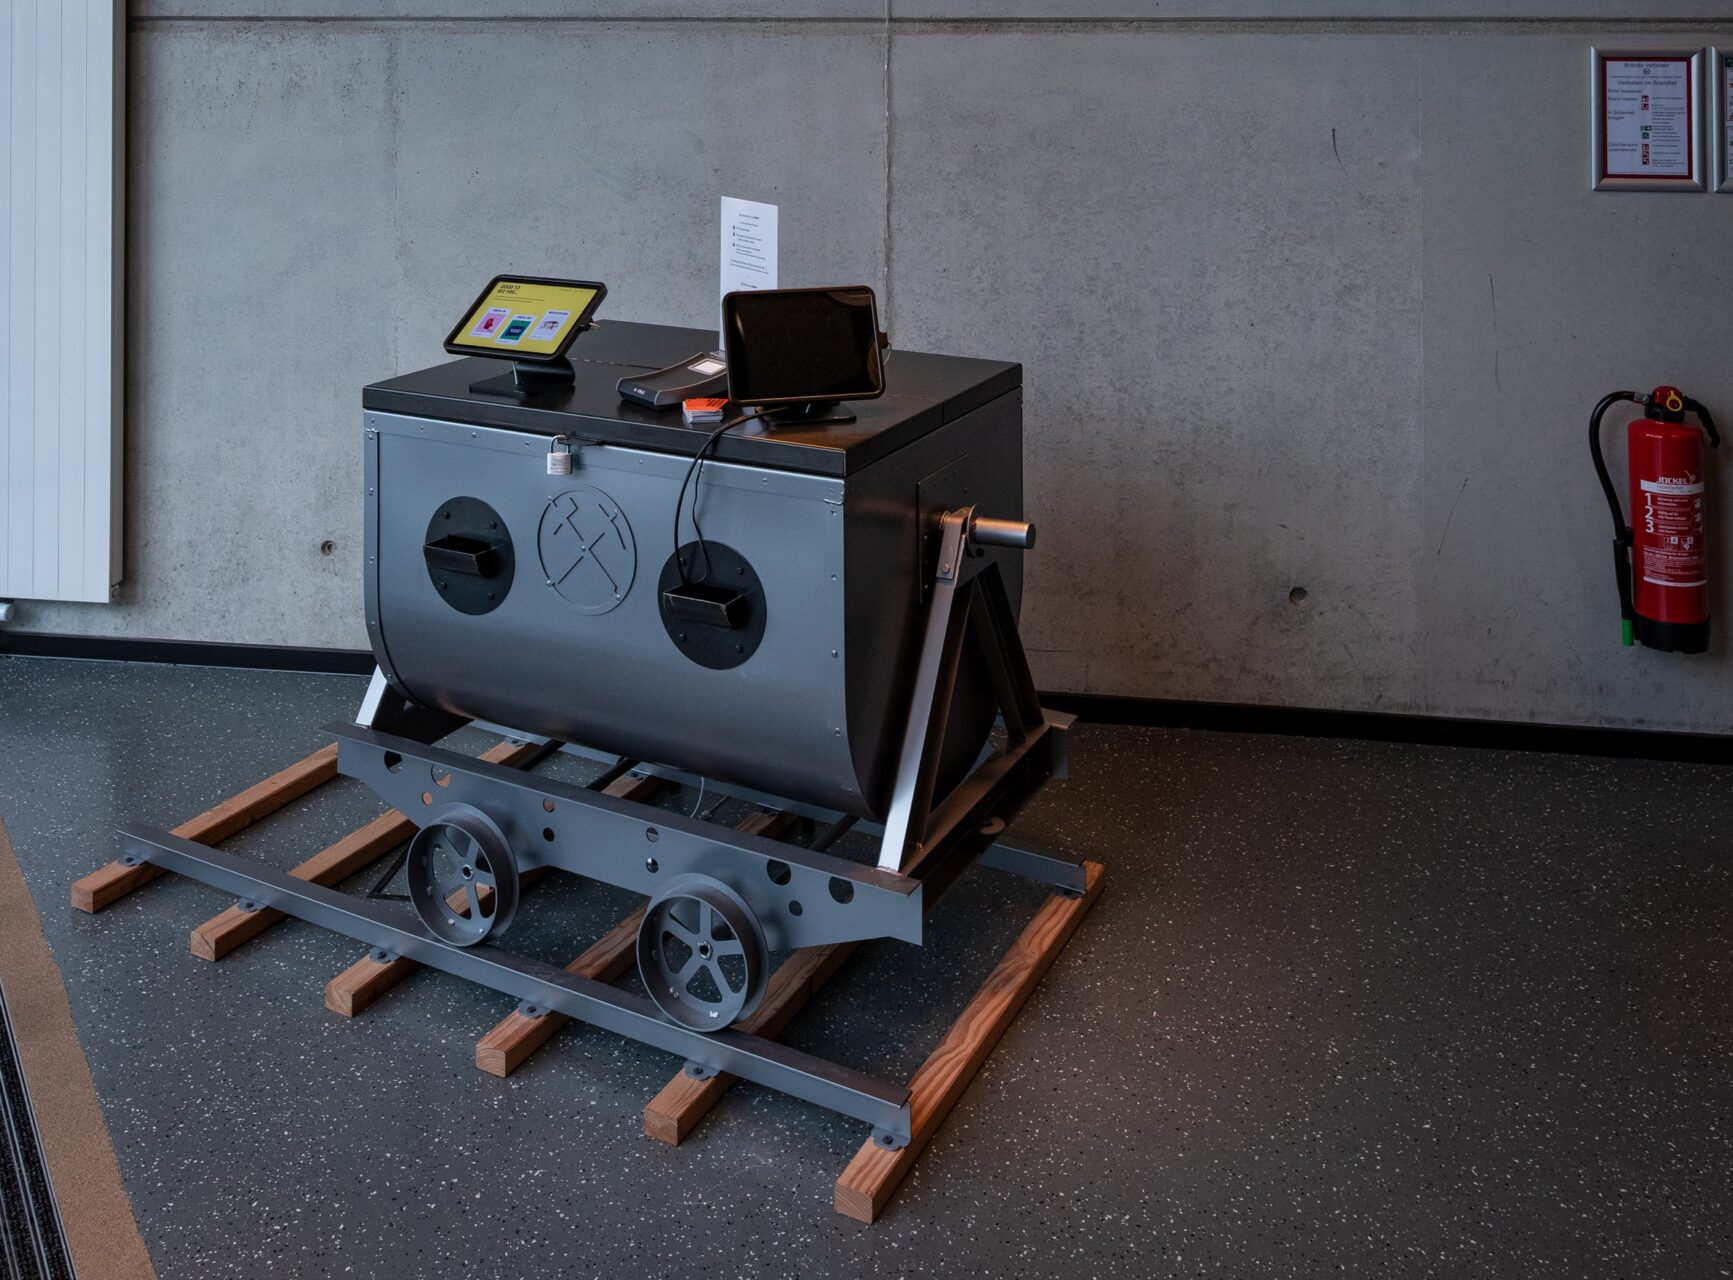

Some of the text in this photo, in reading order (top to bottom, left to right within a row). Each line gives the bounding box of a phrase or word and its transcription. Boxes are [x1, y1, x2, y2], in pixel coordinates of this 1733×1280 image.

[1656, 477, 1689, 485] JOCKEL
[1645, 493, 1652, 506] 1
[1645, 506, 1654, 520] 2
[1645, 519, 1655, 533] 3
